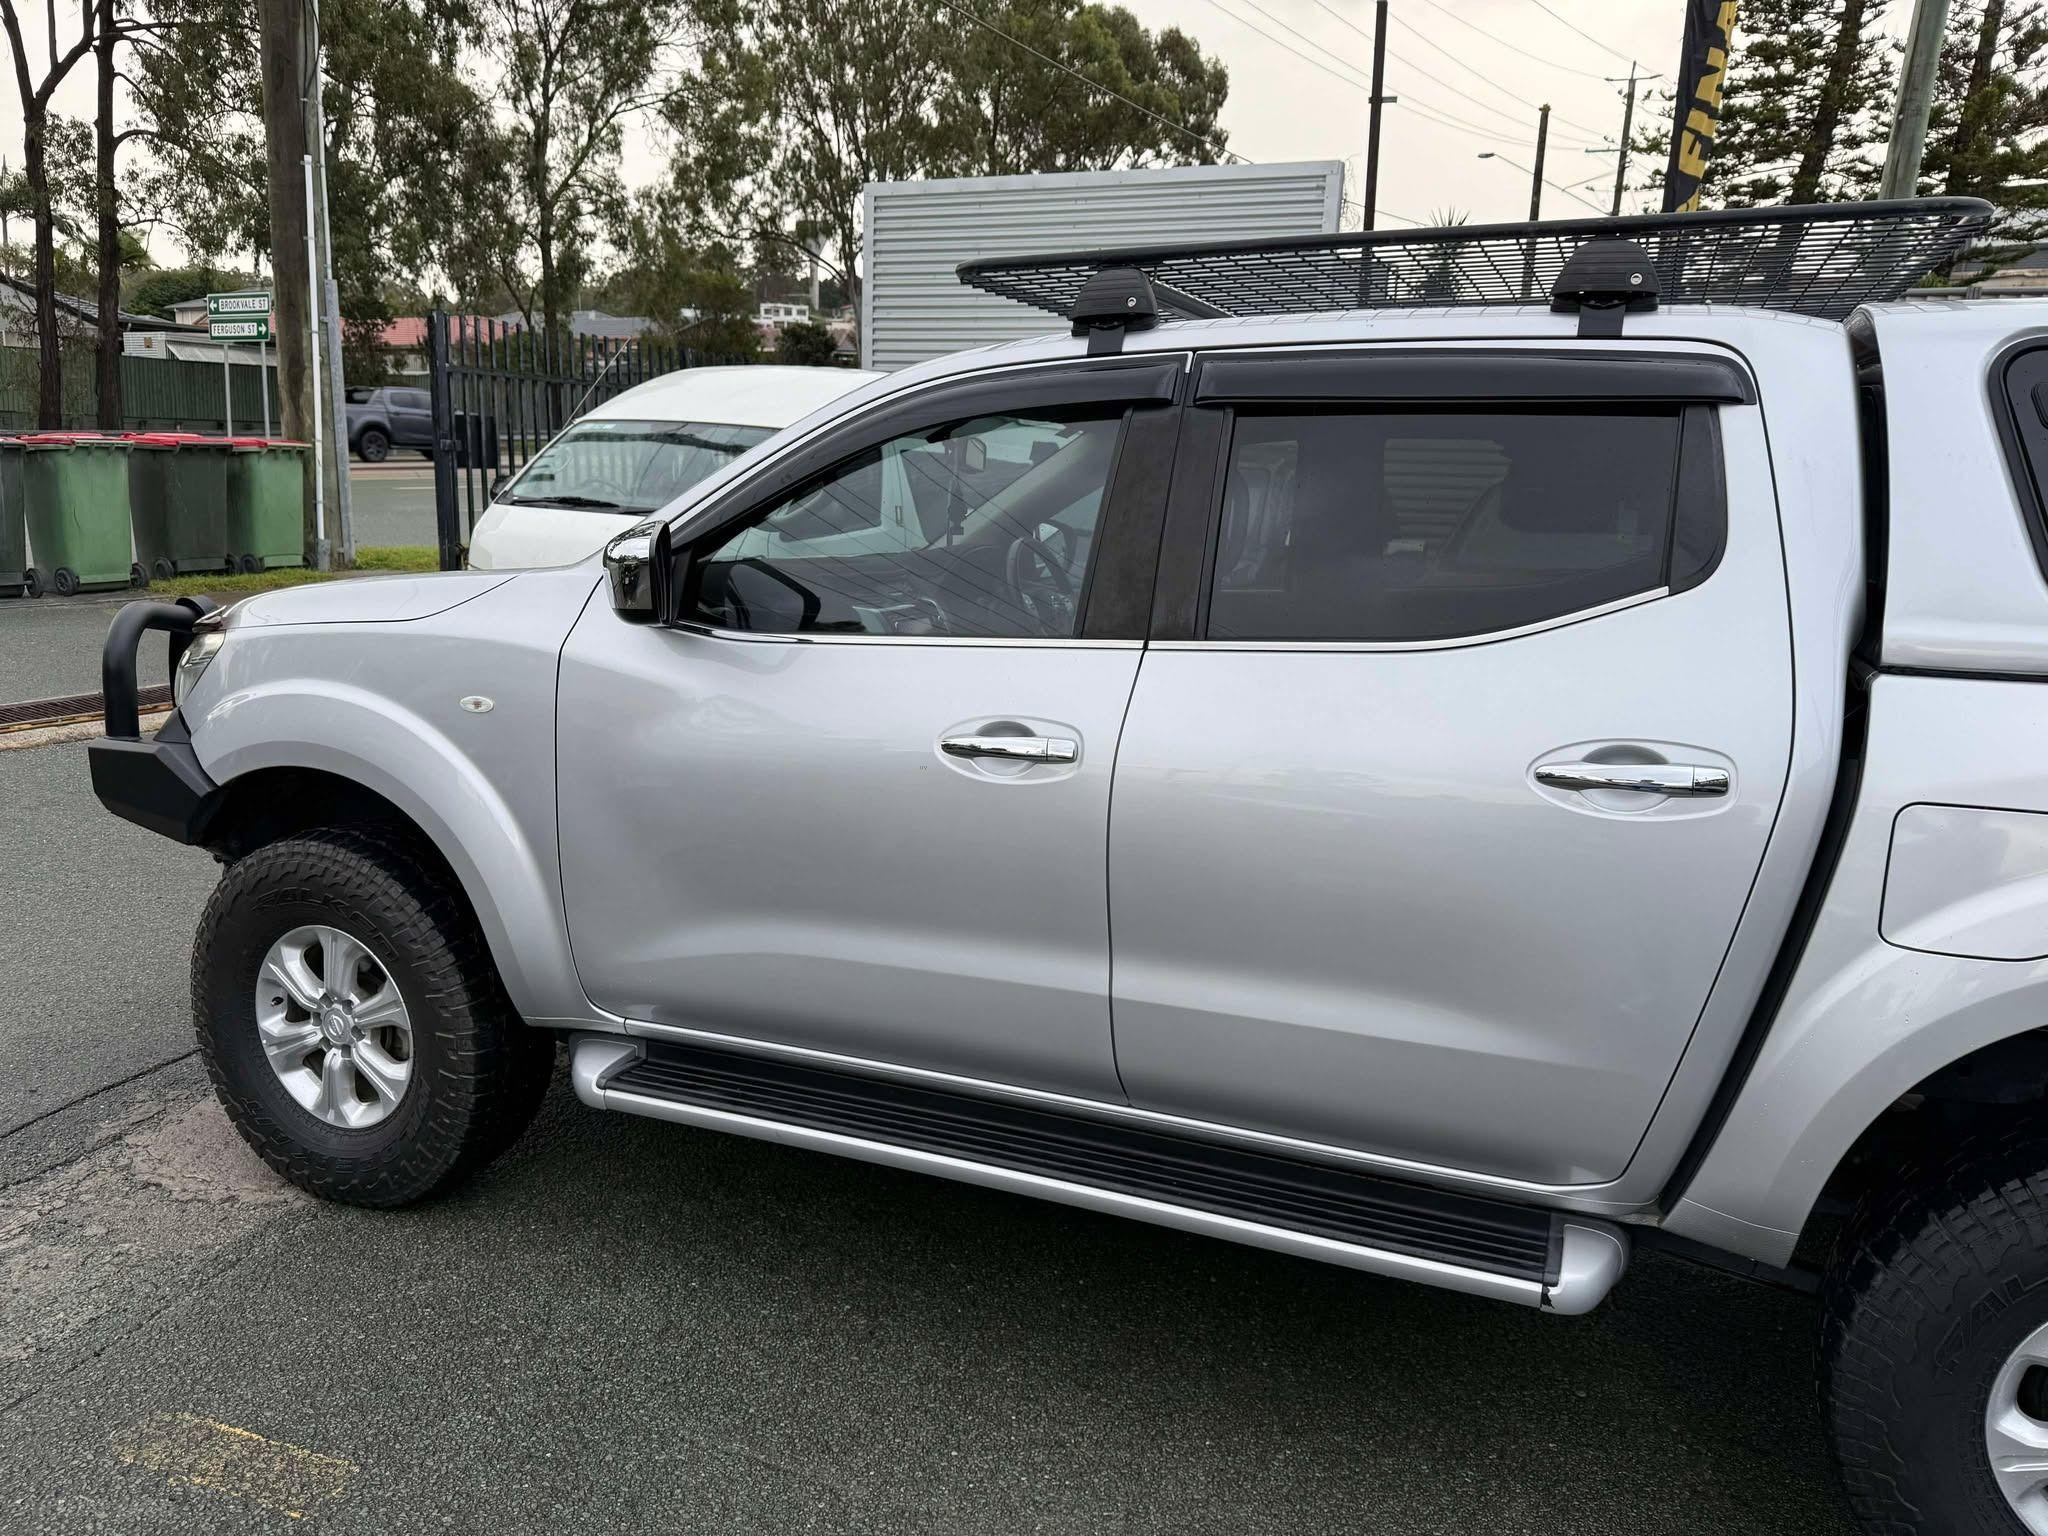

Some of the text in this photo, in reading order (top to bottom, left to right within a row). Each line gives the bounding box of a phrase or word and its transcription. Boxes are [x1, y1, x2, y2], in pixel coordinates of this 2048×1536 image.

[220, 298, 267, 310] BROOKVALE ST
[213, 324, 255, 335] FERGUSON ST
